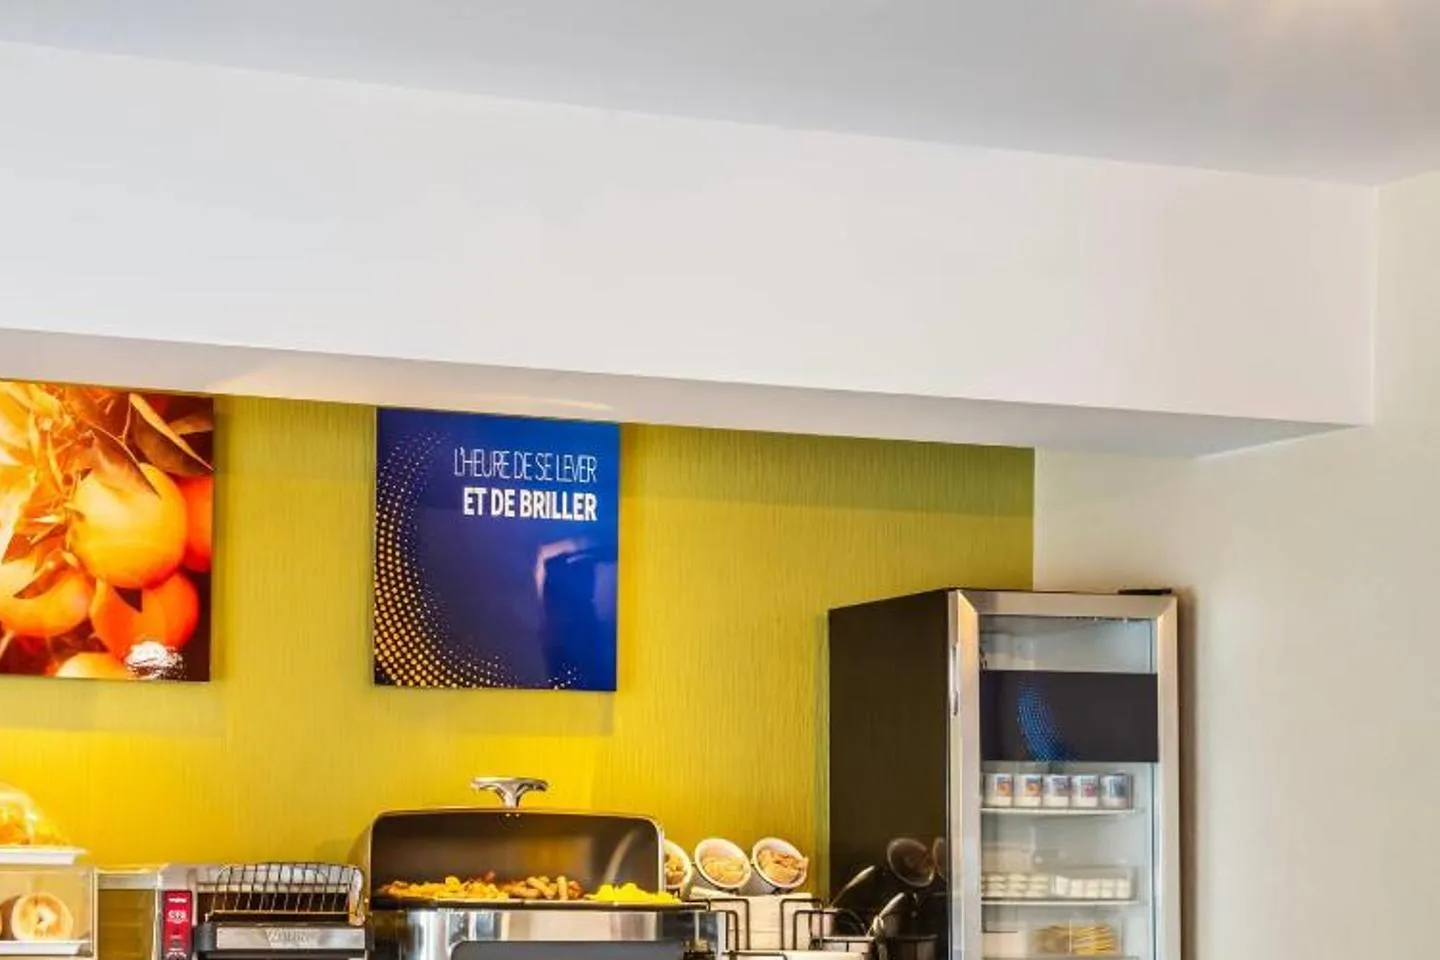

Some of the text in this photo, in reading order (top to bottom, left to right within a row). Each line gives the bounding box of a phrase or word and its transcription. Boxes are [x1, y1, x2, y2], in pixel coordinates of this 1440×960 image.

[454, 447, 598, 483] L'HEURE DE SE LEVER
[464, 487, 598, 521] ET DE BRILLER
